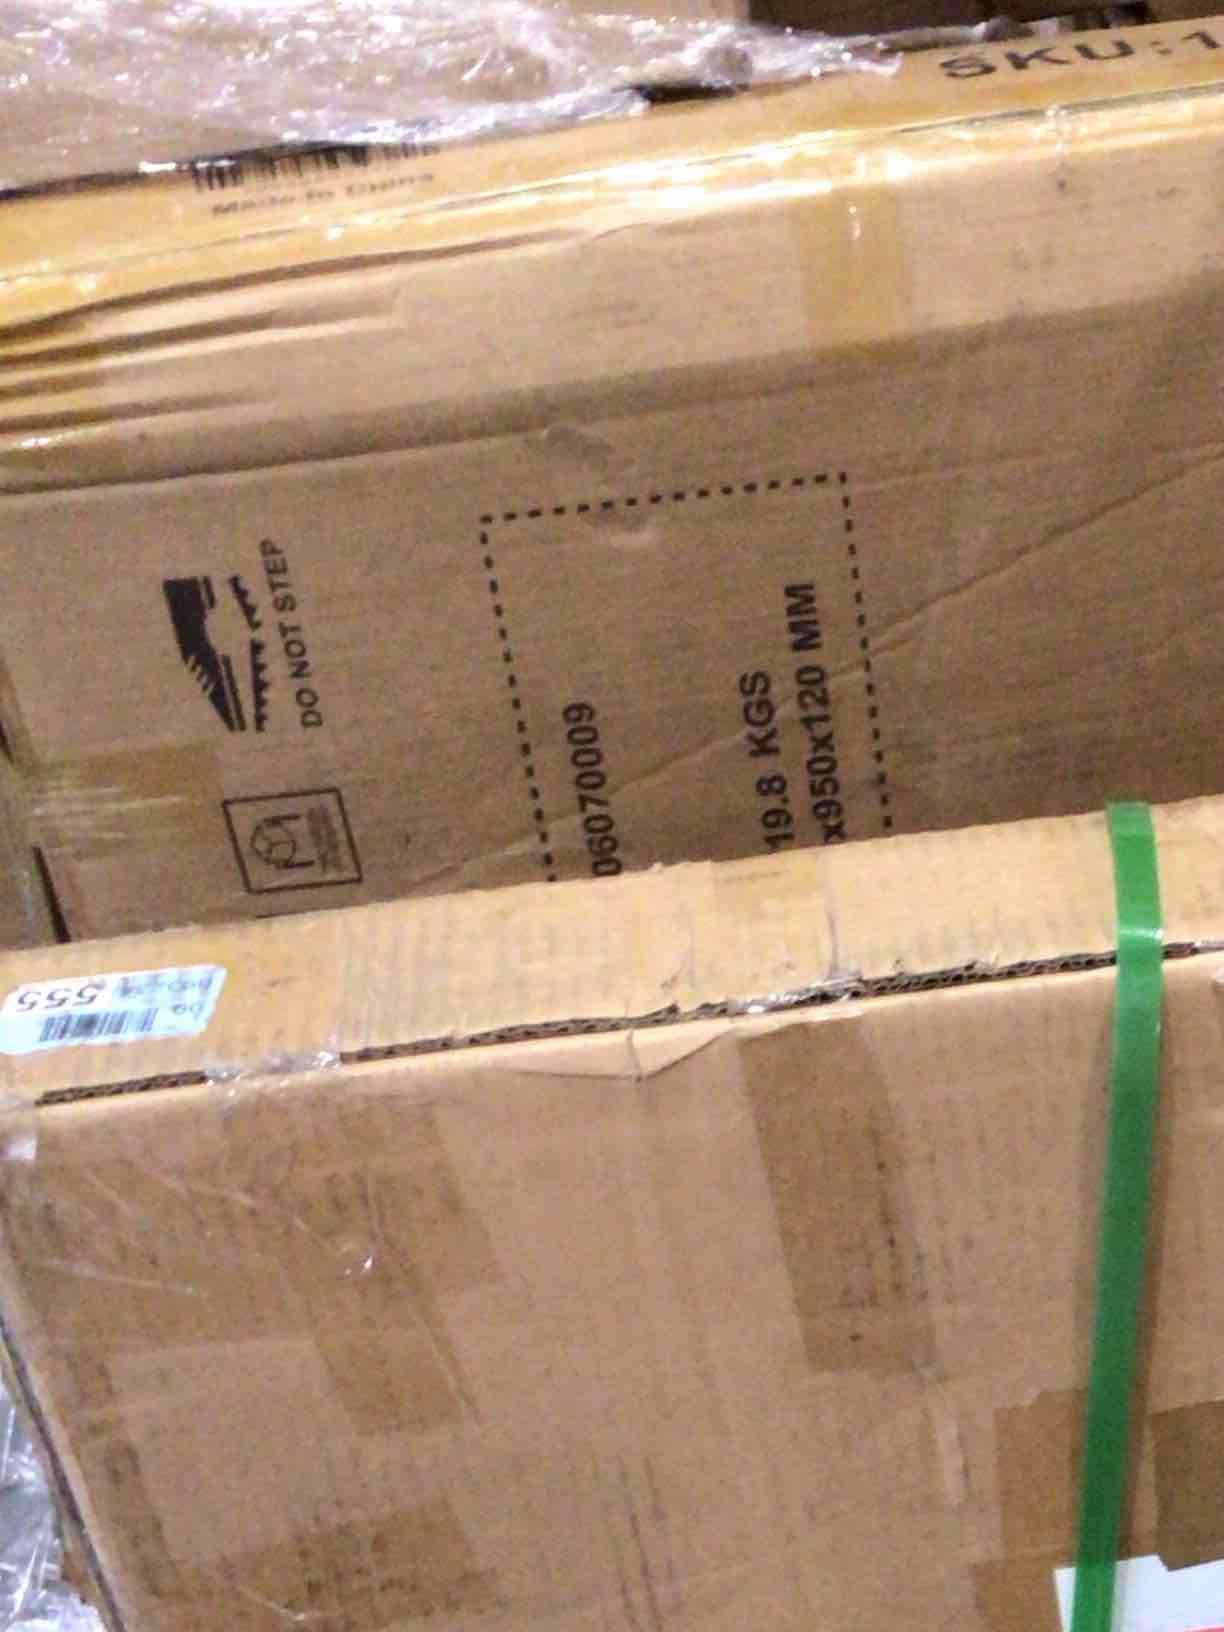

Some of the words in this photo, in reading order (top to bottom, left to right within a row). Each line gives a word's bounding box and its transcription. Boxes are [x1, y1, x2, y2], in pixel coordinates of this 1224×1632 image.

[260, 537, 297, 613] STEP
[279, 621, 311, 679] NOT
[784, 580, 822, 652] MM
[295, 686, 323, 728] DO
[739, 670, 781, 758] KGS
